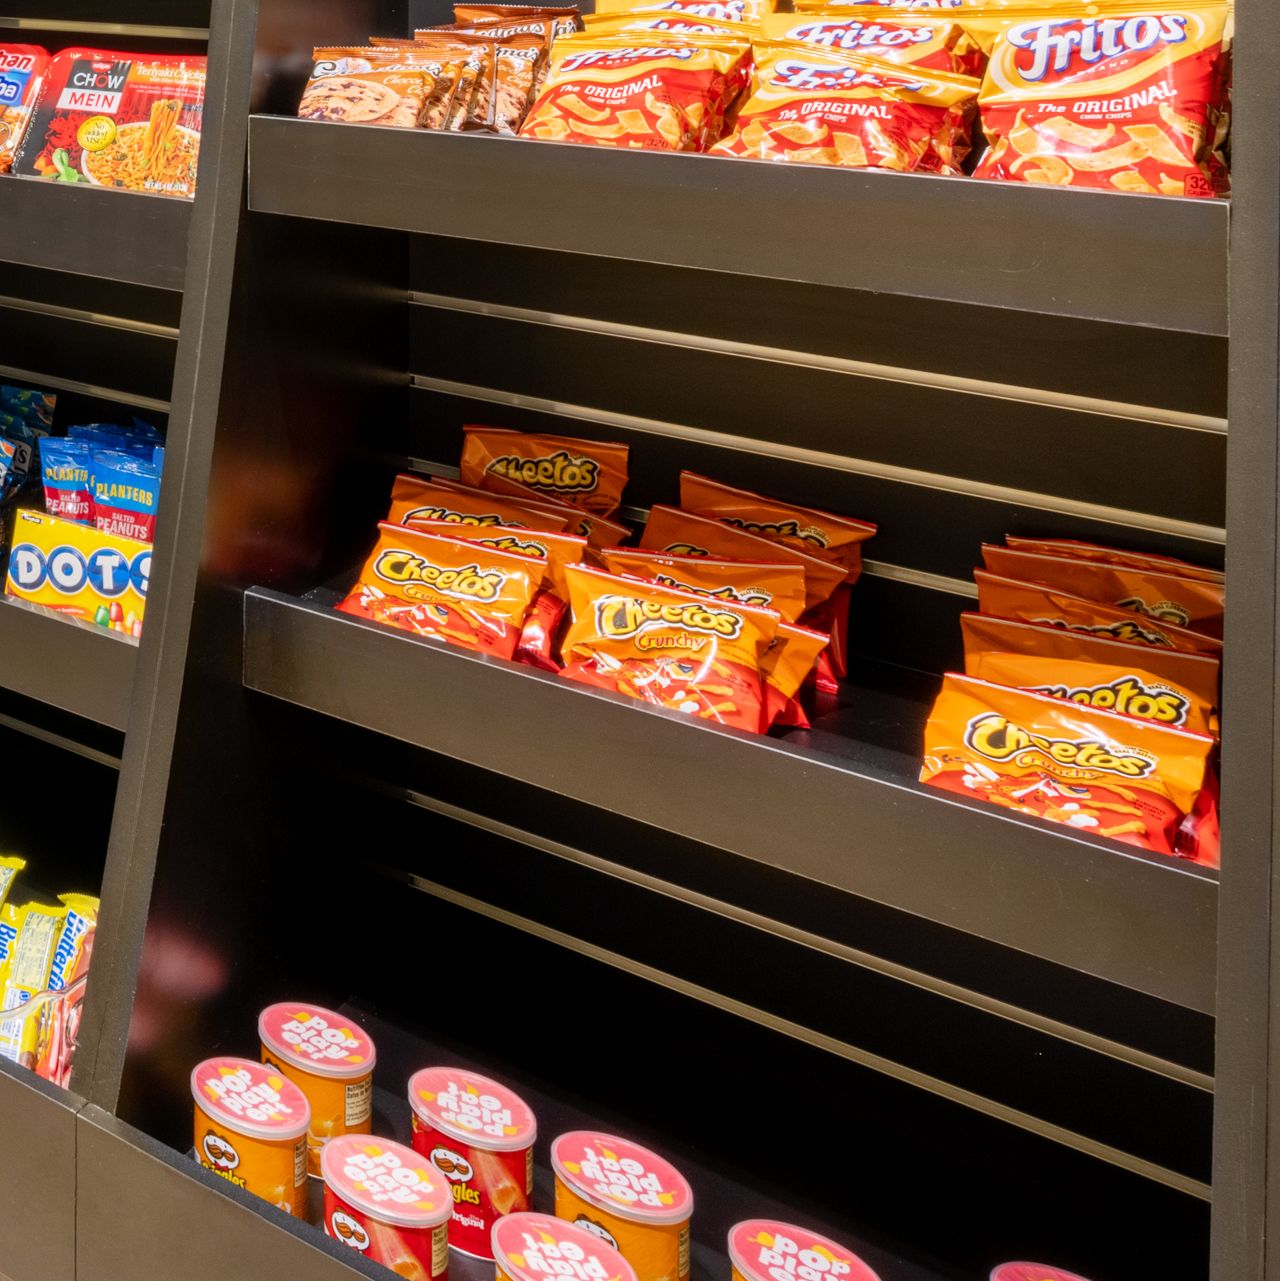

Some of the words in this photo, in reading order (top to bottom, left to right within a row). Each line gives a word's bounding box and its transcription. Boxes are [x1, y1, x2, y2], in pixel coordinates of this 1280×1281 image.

[785, 20, 934, 48] Fritos
[1008, 13, 1188, 82] Fritos
[73, 72, 124, 89] CHOW
[137, 66, 173, 77] Teriyaki
[559, 83, 581, 94] The
[584, 73, 663, 98] ORIGINAL
[69, 92, 115, 109] MEIN
[801, 101, 892, 121] ORIGINAL
[1037, 102, 1067, 115] The
[1072, 80, 1179, 114] ORIGINAL
[46, 498, 89, 514] PEANUTS
[96, 483, 153, 506] PLANTERS
[97, 516, 148, 540] PEANUTS
[112, 512, 135, 522] SALTED
[376, 551, 504, 601] Cheetos
[599, 597, 741, 637] Cheetos
[634, 631, 705, 651] Crunchy
[969, 716, 1147, 778] Cheetos
[1015, 754, 1103, 780] Crunchy
[281, 1031, 326, 1060] eat
[282, 1020, 350, 1059] play
[221, 1082, 281, 1115] play
[437, 1091, 511, 1125] play
[447, 1082, 502, 1108] eat
[245, 1102, 293, 1121] eat
[584, 1147, 645, 1175] eat
[343, 1165, 391, 1202] eat
[345, 1154, 421, 1204] play
[579, 1160, 663, 1192] play
[521, 1232, 585, 1261] eat
[522, 1249, 608, 1278] play
